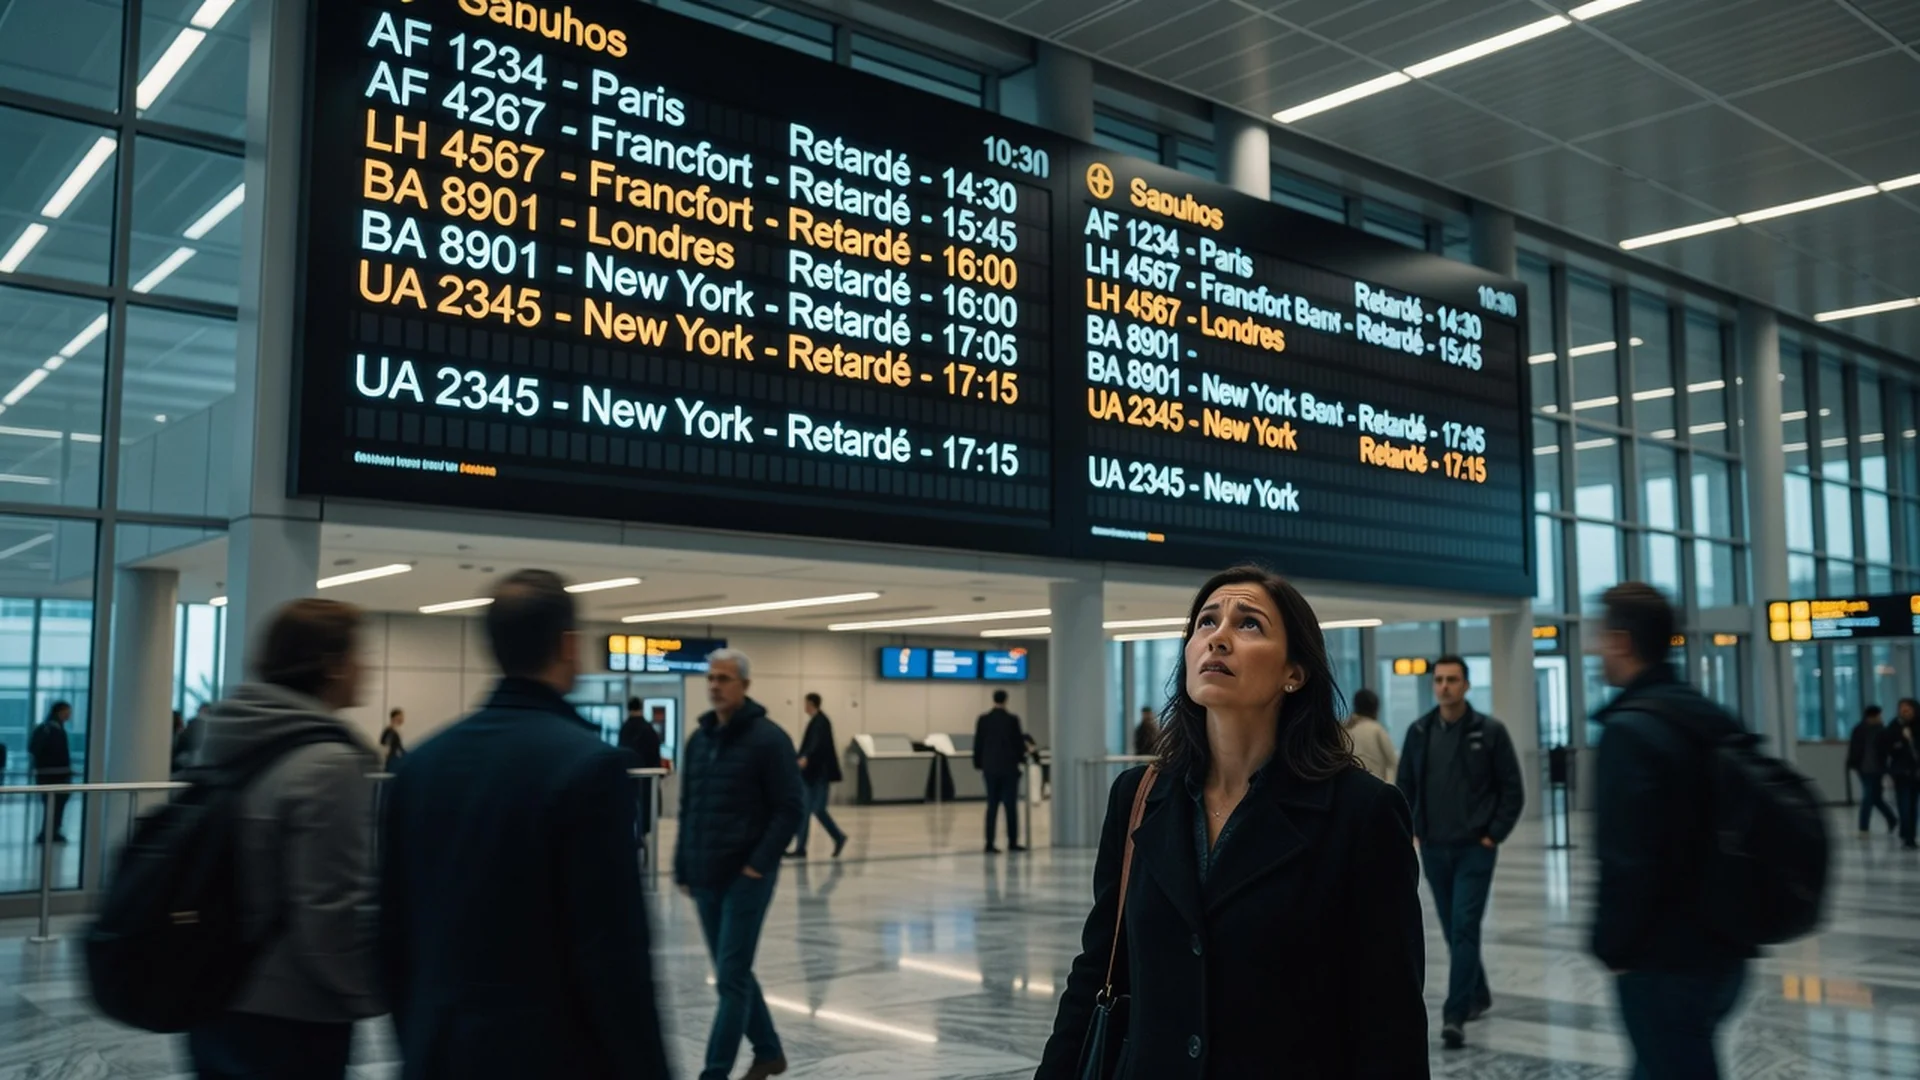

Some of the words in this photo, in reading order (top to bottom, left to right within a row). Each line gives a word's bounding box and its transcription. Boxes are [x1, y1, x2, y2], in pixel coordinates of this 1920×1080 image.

[364, 60, 429, 106] AF
[441, 80, 547, 136] 4267
[561, 125, 578, 136] -
[591, 114, 754, 189] Francfort
[765, 175, 780, 186] -
[789, 164, 911, 226] Retardé
[921, 214, 933, 224] -
[942, 206, 1018, 253] 15:45
[367, 11, 432, 58] AF
[449, 32, 548, 91] 1234
[562, 79, 579, 90] -
[591, 68, 685, 127] Paris
[789, 122, 911, 187] Retardé
[919, 175, 933, 184] -
[942, 167, 1018, 214] 14:30
[363, 158, 429, 210] BA
[440, 176, 537, 231] 8901
[560, 218, 577, 228] -
[588, 206, 735, 270] Londres
[789, 248, 912, 307] Retardé
[919, 293, 933, 302] -
[942, 283, 1018, 328] 16:00
[366, 108, 427, 160] LH
[440, 129, 545, 183] 4567
[560, 171, 577, 182] -
[590, 159, 754, 232] Francfort
[765, 217, 779, 228] -
[789, 206, 912, 266] Retardé
[920, 254, 933, 262] -
[943, 245, 1018, 290] 16:00
[359, 259, 428, 309] UA
[437, 274, 542, 328] 2345
[555, 312, 572, 322] -
[584, 297, 668, 347] New
[675, 313, 755, 361] York
[764, 347, 778, 357] -
[788, 333, 912, 387] Retardé
[920, 373, 933, 382] -
[943, 362, 1018, 405] 17:15
[361, 209, 427, 259] BA
[438, 224, 536, 279] 8901
[556, 264, 574, 275] -
[585, 251, 670, 301] New
[676, 269, 755, 318] York
[764, 303, 779, 313] -
[788, 291, 911, 347] Retardé
[920, 333, 933, 343] -
[942, 323, 1018, 367] 17:05
[1084, 207, 1120, 241] AF
[1126, 218, 1180, 259] 1234
[1199, 237, 1254, 279] Paris
[1437, 305, 1482, 341] 14:30
[1086, 242, 1120, 279] LH
[1123, 253, 1181, 293] 4567
[1200, 271, 1293, 322] Francfort
[1438, 336, 1483, 371] 15:45
[1086, 277, 1120, 314] LH
[1124, 288, 1182, 327] 4567
[1201, 305, 1286, 352] Londres
[1086, 314, 1123, 350] BA
[1125, 323, 1179, 362] 8901
[355, 353, 424, 403] UA
[435, 366, 540, 417] 2345
[552, 400, 569, 410] -
[582, 384, 668, 432] New
[674, 397, 754, 444] York
[763, 427, 778, 437] -
[788, 413, 911, 463] Retardé
[920, 448, 933, 457] -
[942, 435, 1019, 477] 17:15
[1087, 350, 1124, 386] BA
[1126, 358, 1180, 397] 8901
[1202, 372, 1250, 409] New
[1250, 381, 1298, 418] York
[1088, 387, 1125, 423] UA
[1127, 394, 1185, 433] 2345
[1203, 407, 1251, 443] New
[1252, 416, 1298, 451] York
[1443, 451, 1487, 483] 17:15
[1088, 455, 1126, 490] UA
[1128, 461, 1186, 498] 2345
[1203, 471, 1252, 506] New
[1253, 477, 1300, 512] York
